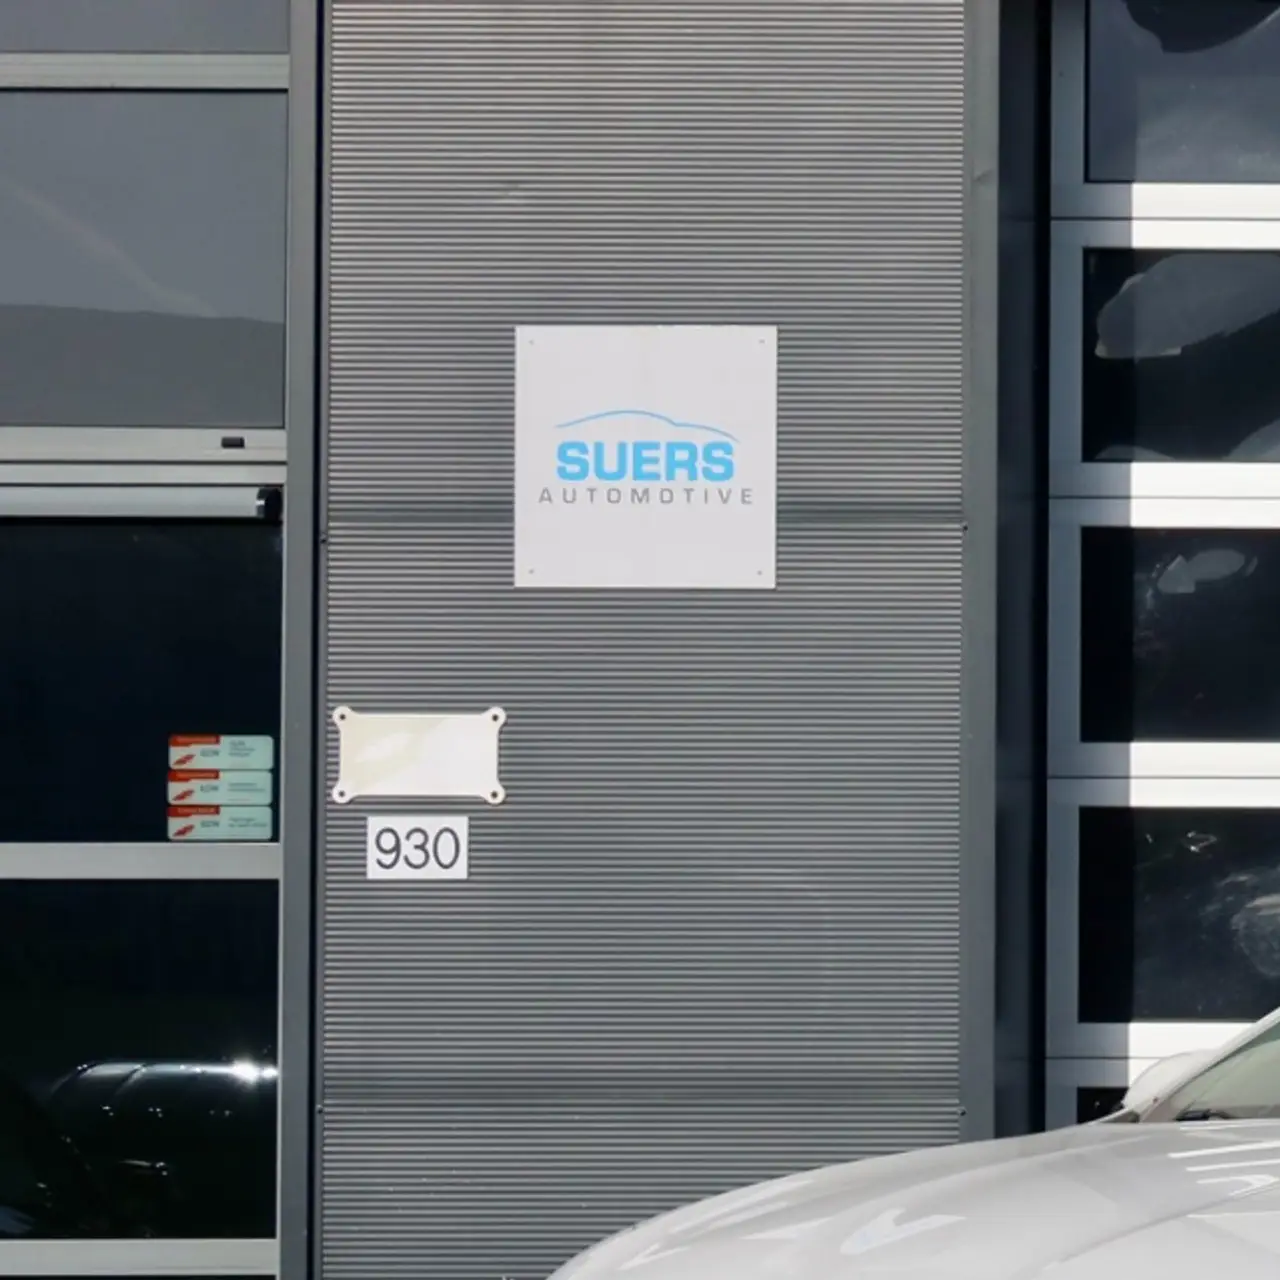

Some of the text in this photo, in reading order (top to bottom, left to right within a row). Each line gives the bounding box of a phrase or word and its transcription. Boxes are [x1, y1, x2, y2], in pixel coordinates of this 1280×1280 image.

[556, 440, 734, 482] SUERS
[538, 488, 753, 505] AUTOMOTIVE
[375, 827, 460, 869] 930
